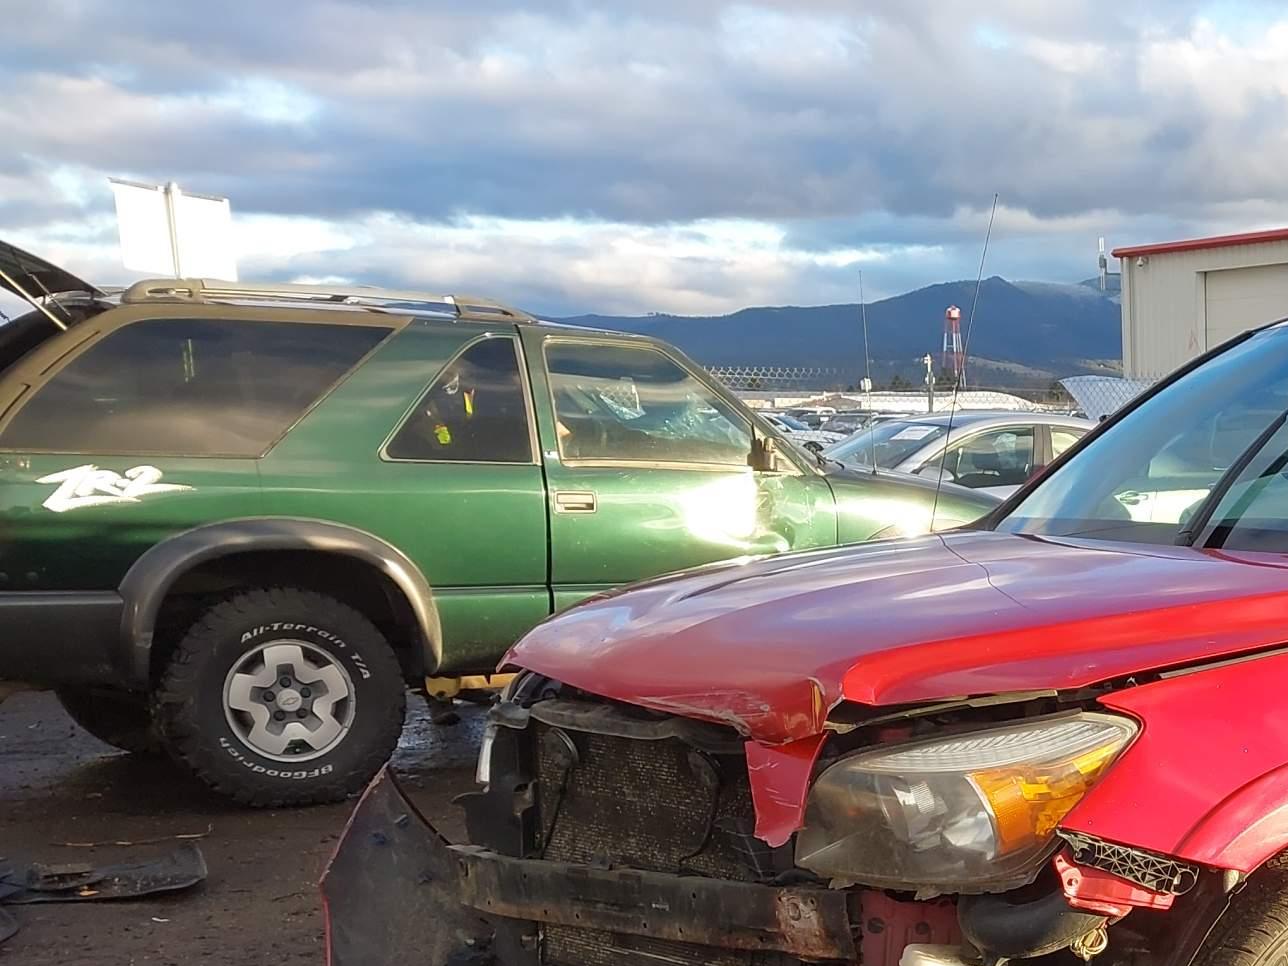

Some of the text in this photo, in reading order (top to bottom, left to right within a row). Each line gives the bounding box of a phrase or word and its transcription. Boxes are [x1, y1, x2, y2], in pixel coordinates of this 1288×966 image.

[240, 622, 371, 680] All-Terrain T/A
[219, 736, 333, 779] BFGoodrich
